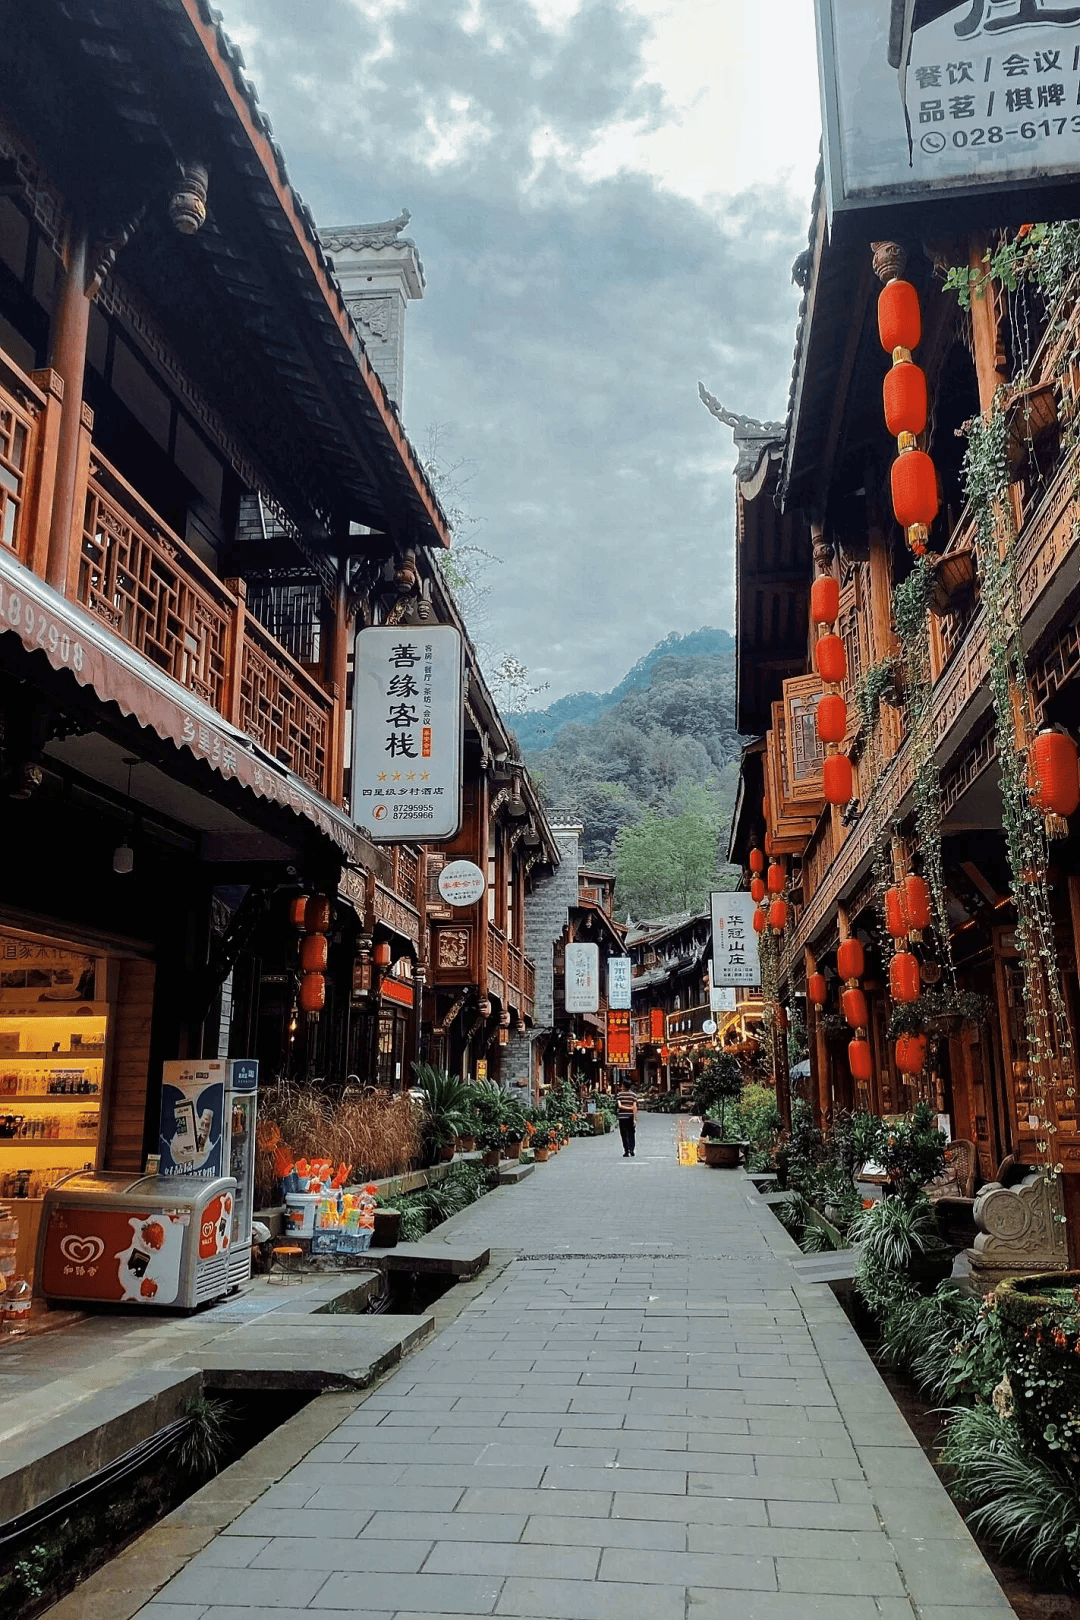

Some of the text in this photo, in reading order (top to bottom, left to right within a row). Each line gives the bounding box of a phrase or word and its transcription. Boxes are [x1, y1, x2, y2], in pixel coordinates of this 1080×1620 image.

[384, 643, 421, 759] 善缘客栈
[362, 787, 445, 796] 四星级乡村酒店
[727, 915, 745, 965] 华冠山庄
